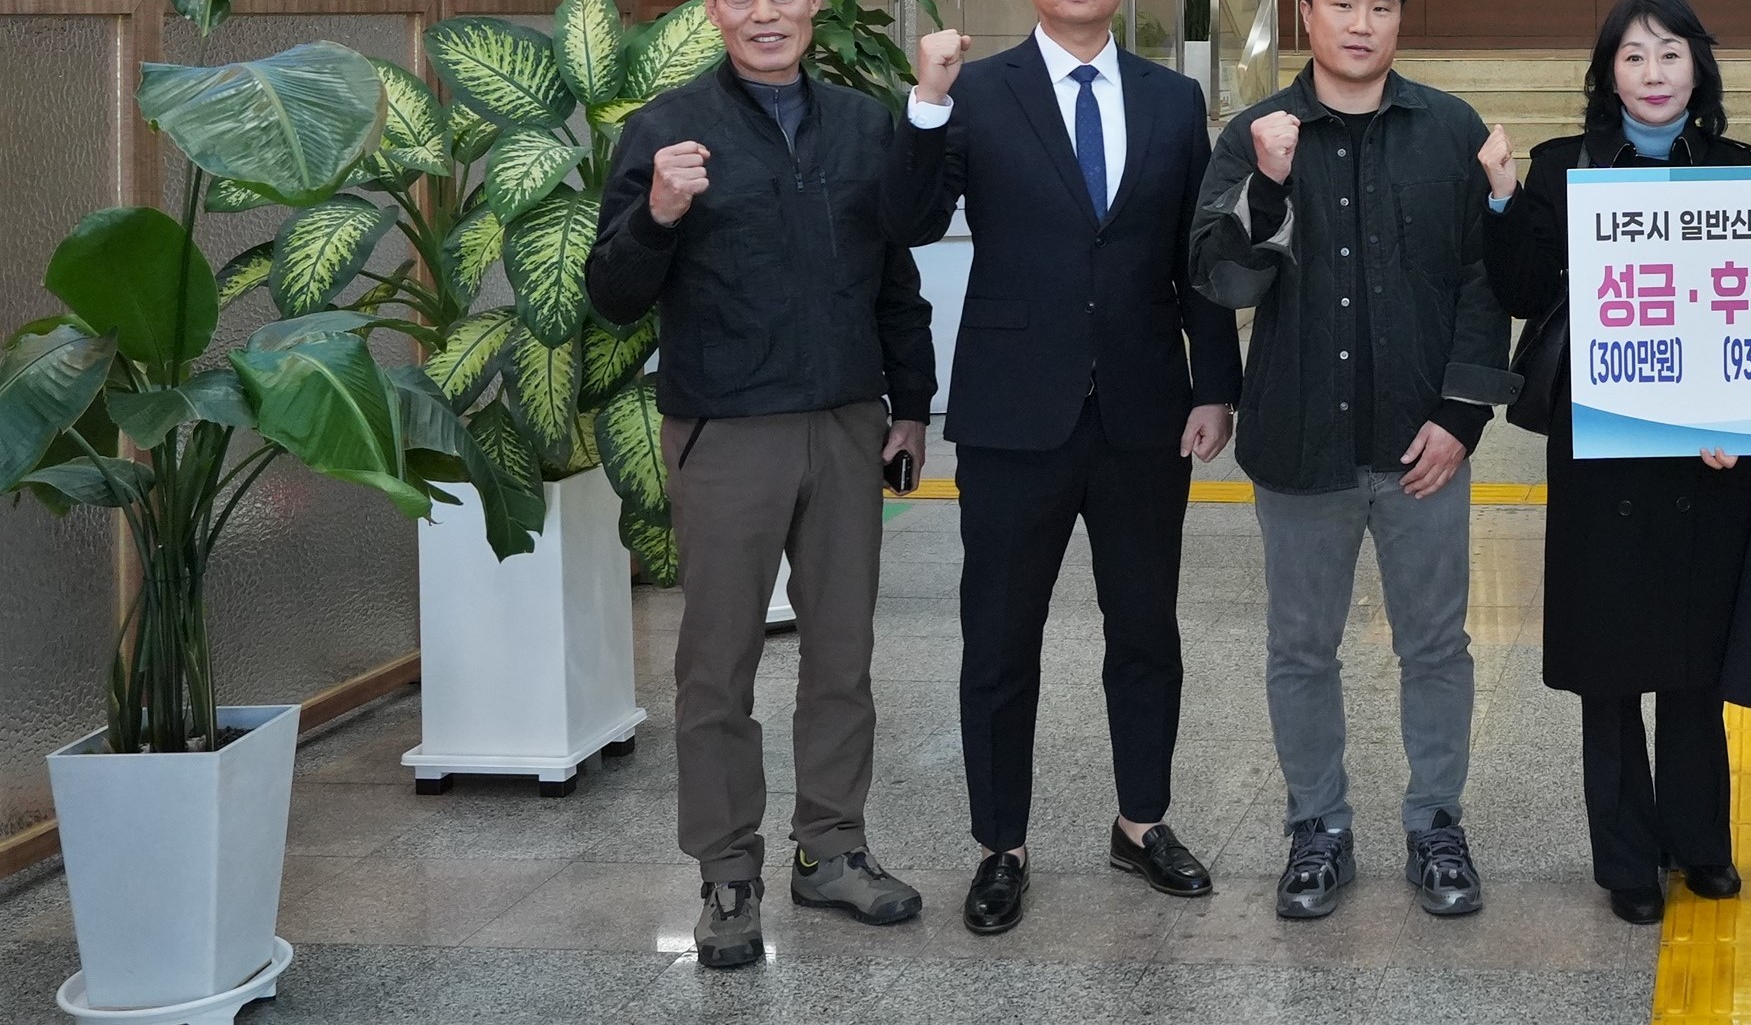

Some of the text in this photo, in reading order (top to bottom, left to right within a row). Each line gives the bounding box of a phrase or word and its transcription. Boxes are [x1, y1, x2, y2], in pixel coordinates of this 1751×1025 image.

[1595, 210, 1670, 243] 나주시
[1597, 263, 1676, 328] 성금
[1589, 336, 1683, 386] (300만원)
